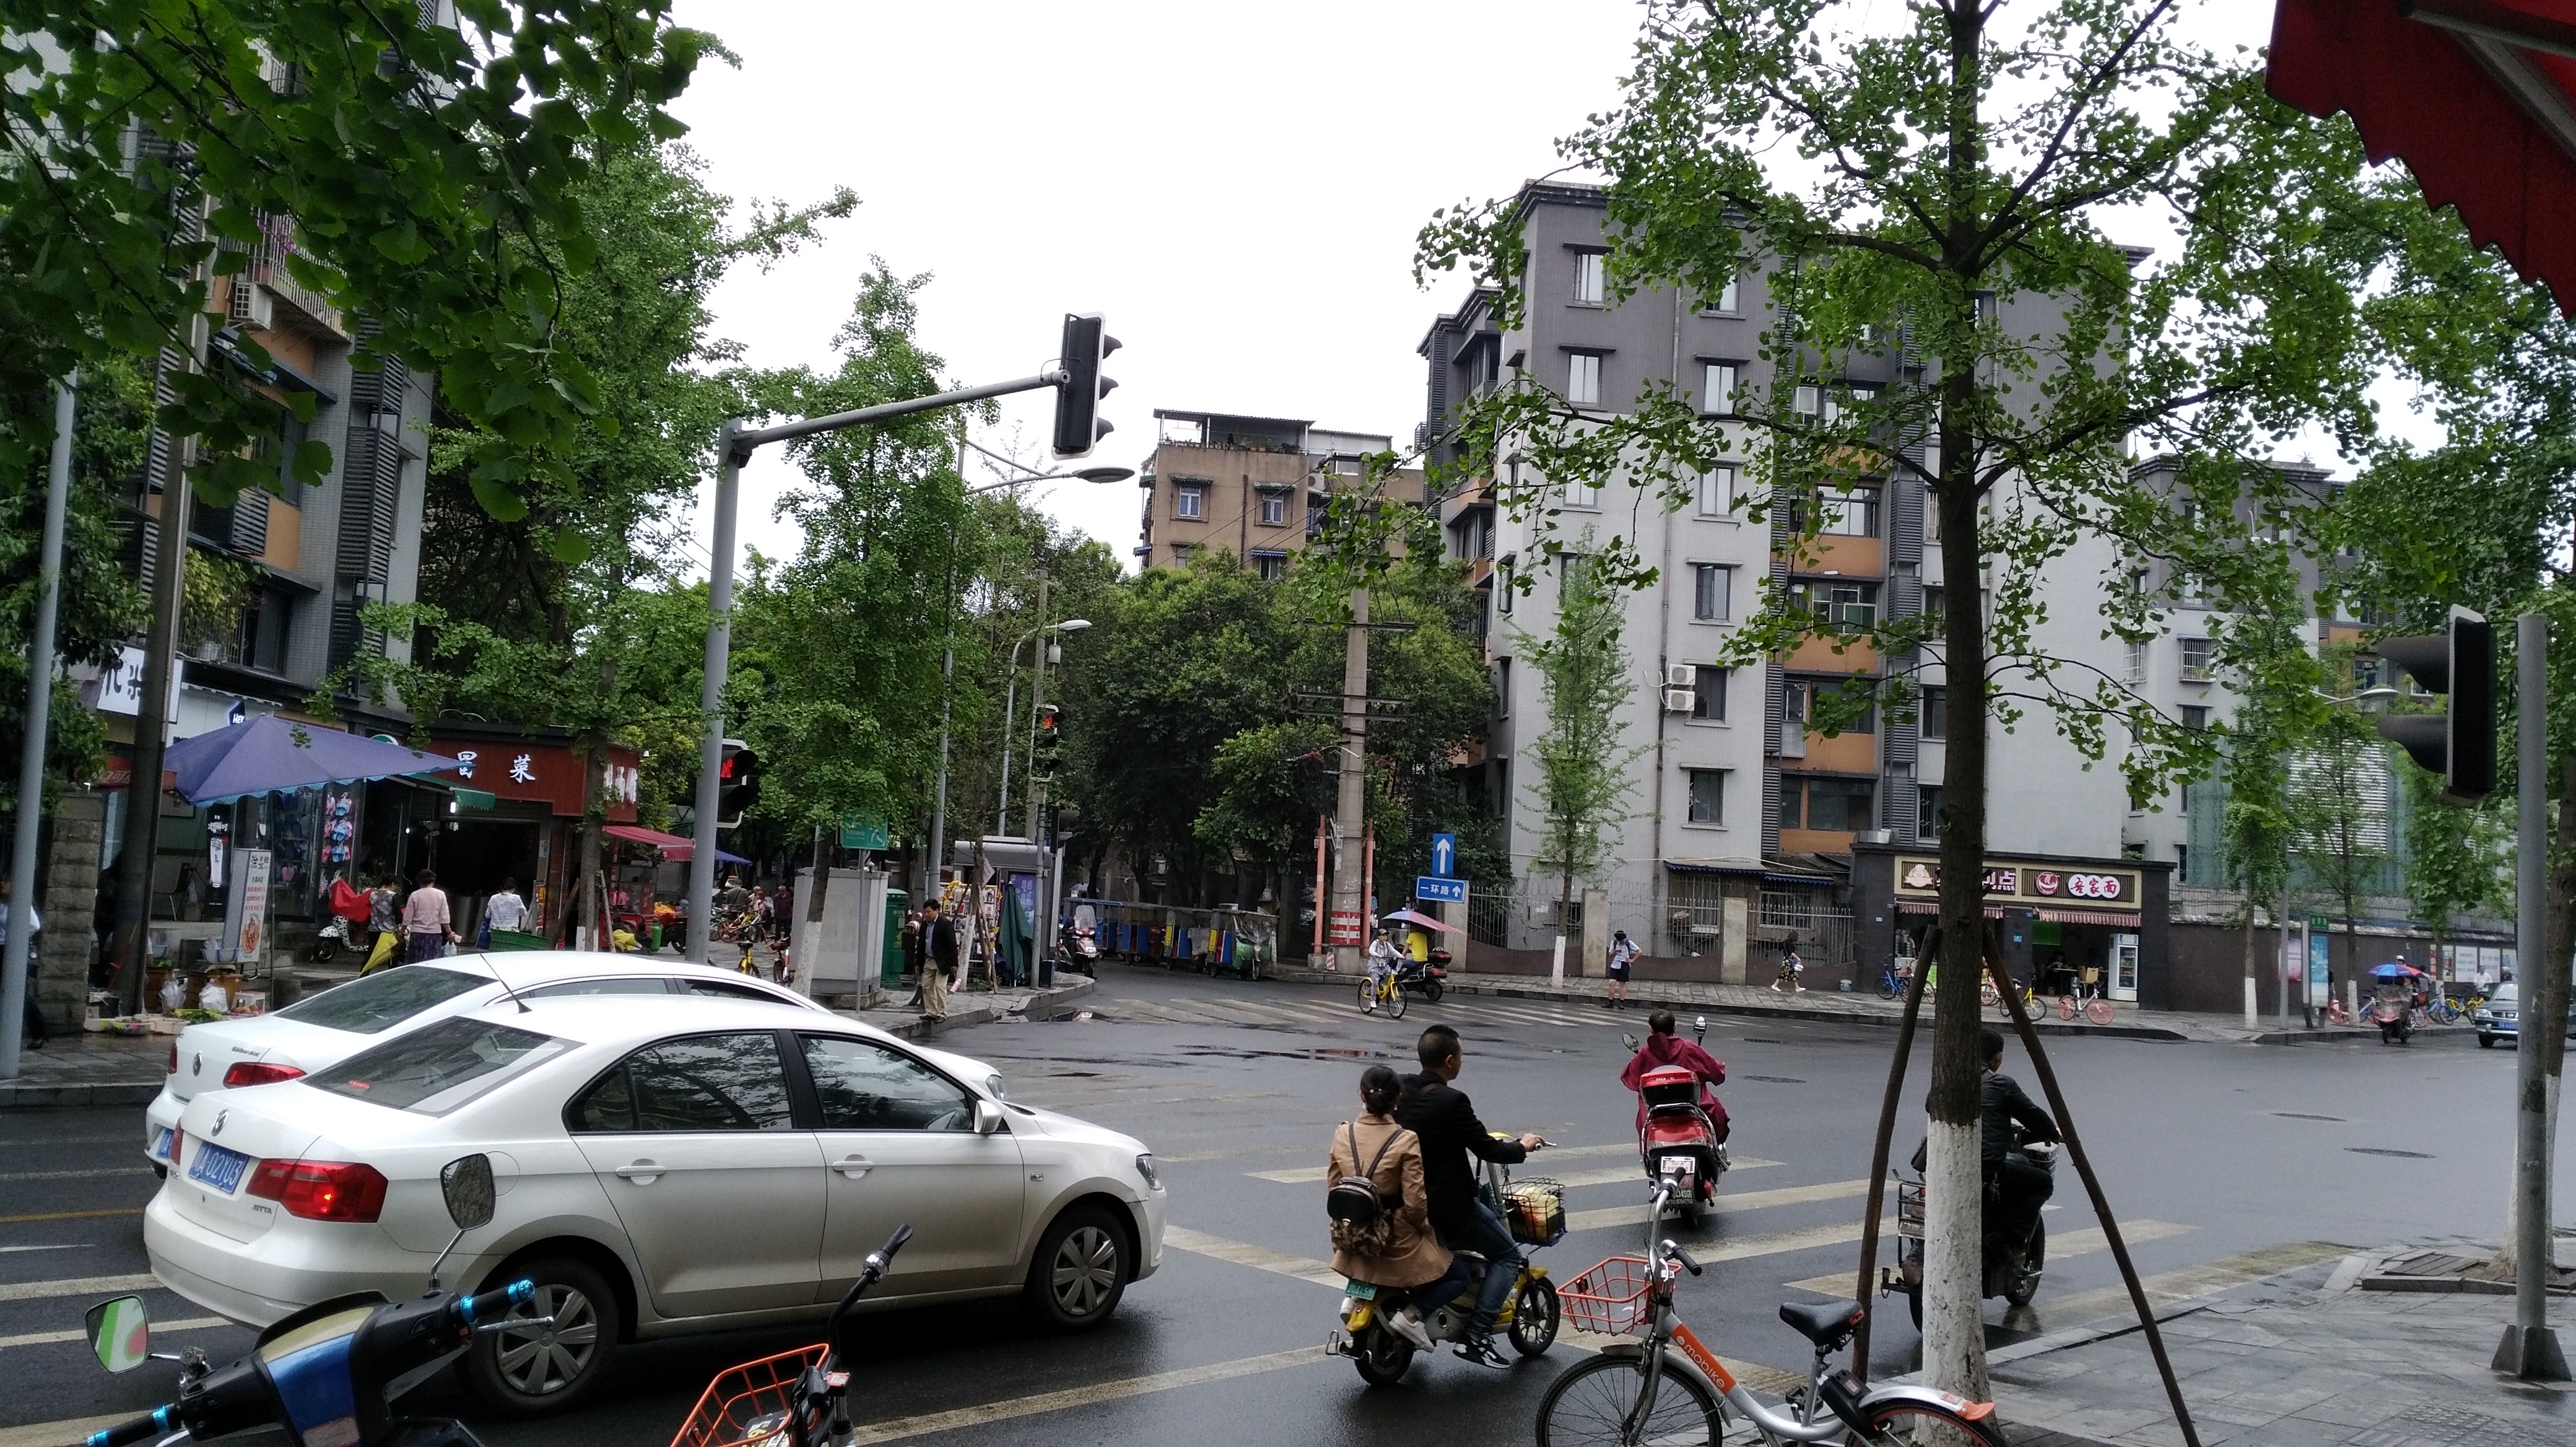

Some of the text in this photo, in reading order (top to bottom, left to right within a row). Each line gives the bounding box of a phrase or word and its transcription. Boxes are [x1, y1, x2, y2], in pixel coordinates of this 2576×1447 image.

[1420, 884, 1450, 896] 一环路
[251, 1204, 272, 1214] JETTA
[1684, 1344, 1725, 1388] mobike
